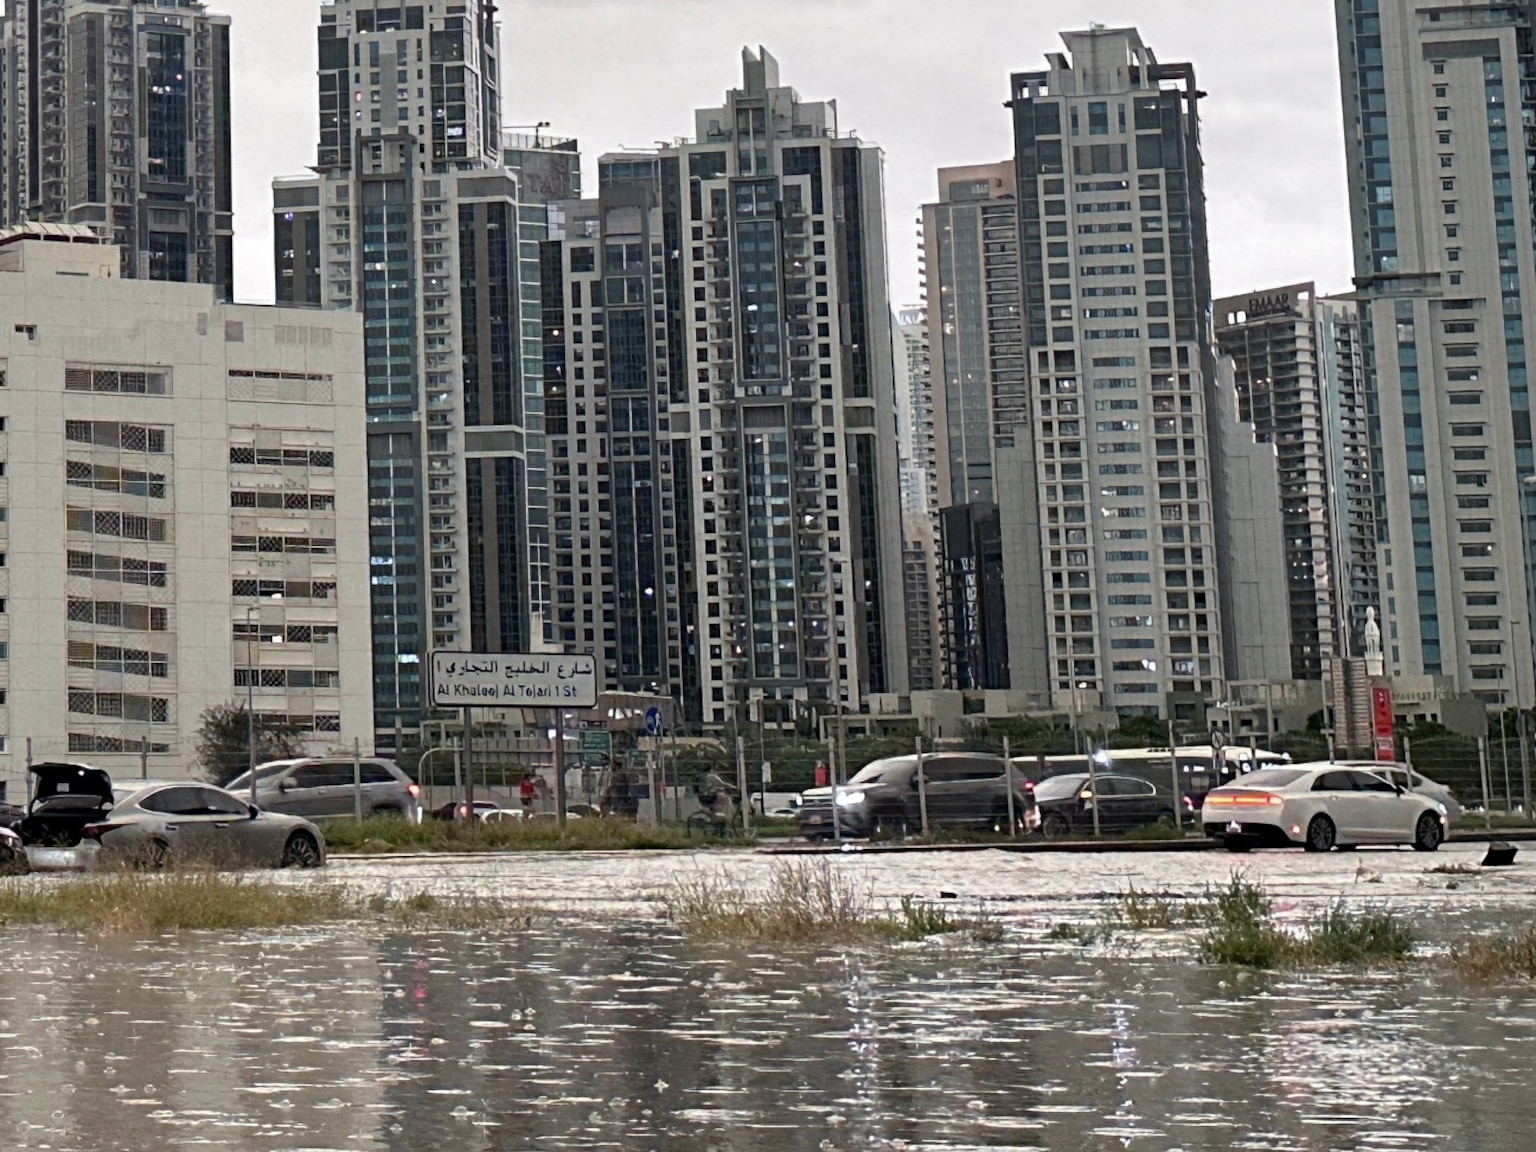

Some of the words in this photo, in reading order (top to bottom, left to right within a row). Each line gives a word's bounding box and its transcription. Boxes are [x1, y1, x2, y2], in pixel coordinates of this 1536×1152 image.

[445, 660, 498, 678] التجاري
[505, 661, 550, 679] الخليج
[557, 660, 592, 679] شارع
[437, 683, 450, 696] Al
[454, 684, 498, 699] Khaleej
[503, 684, 515, 697] Al
[563, 685, 577, 698] St
